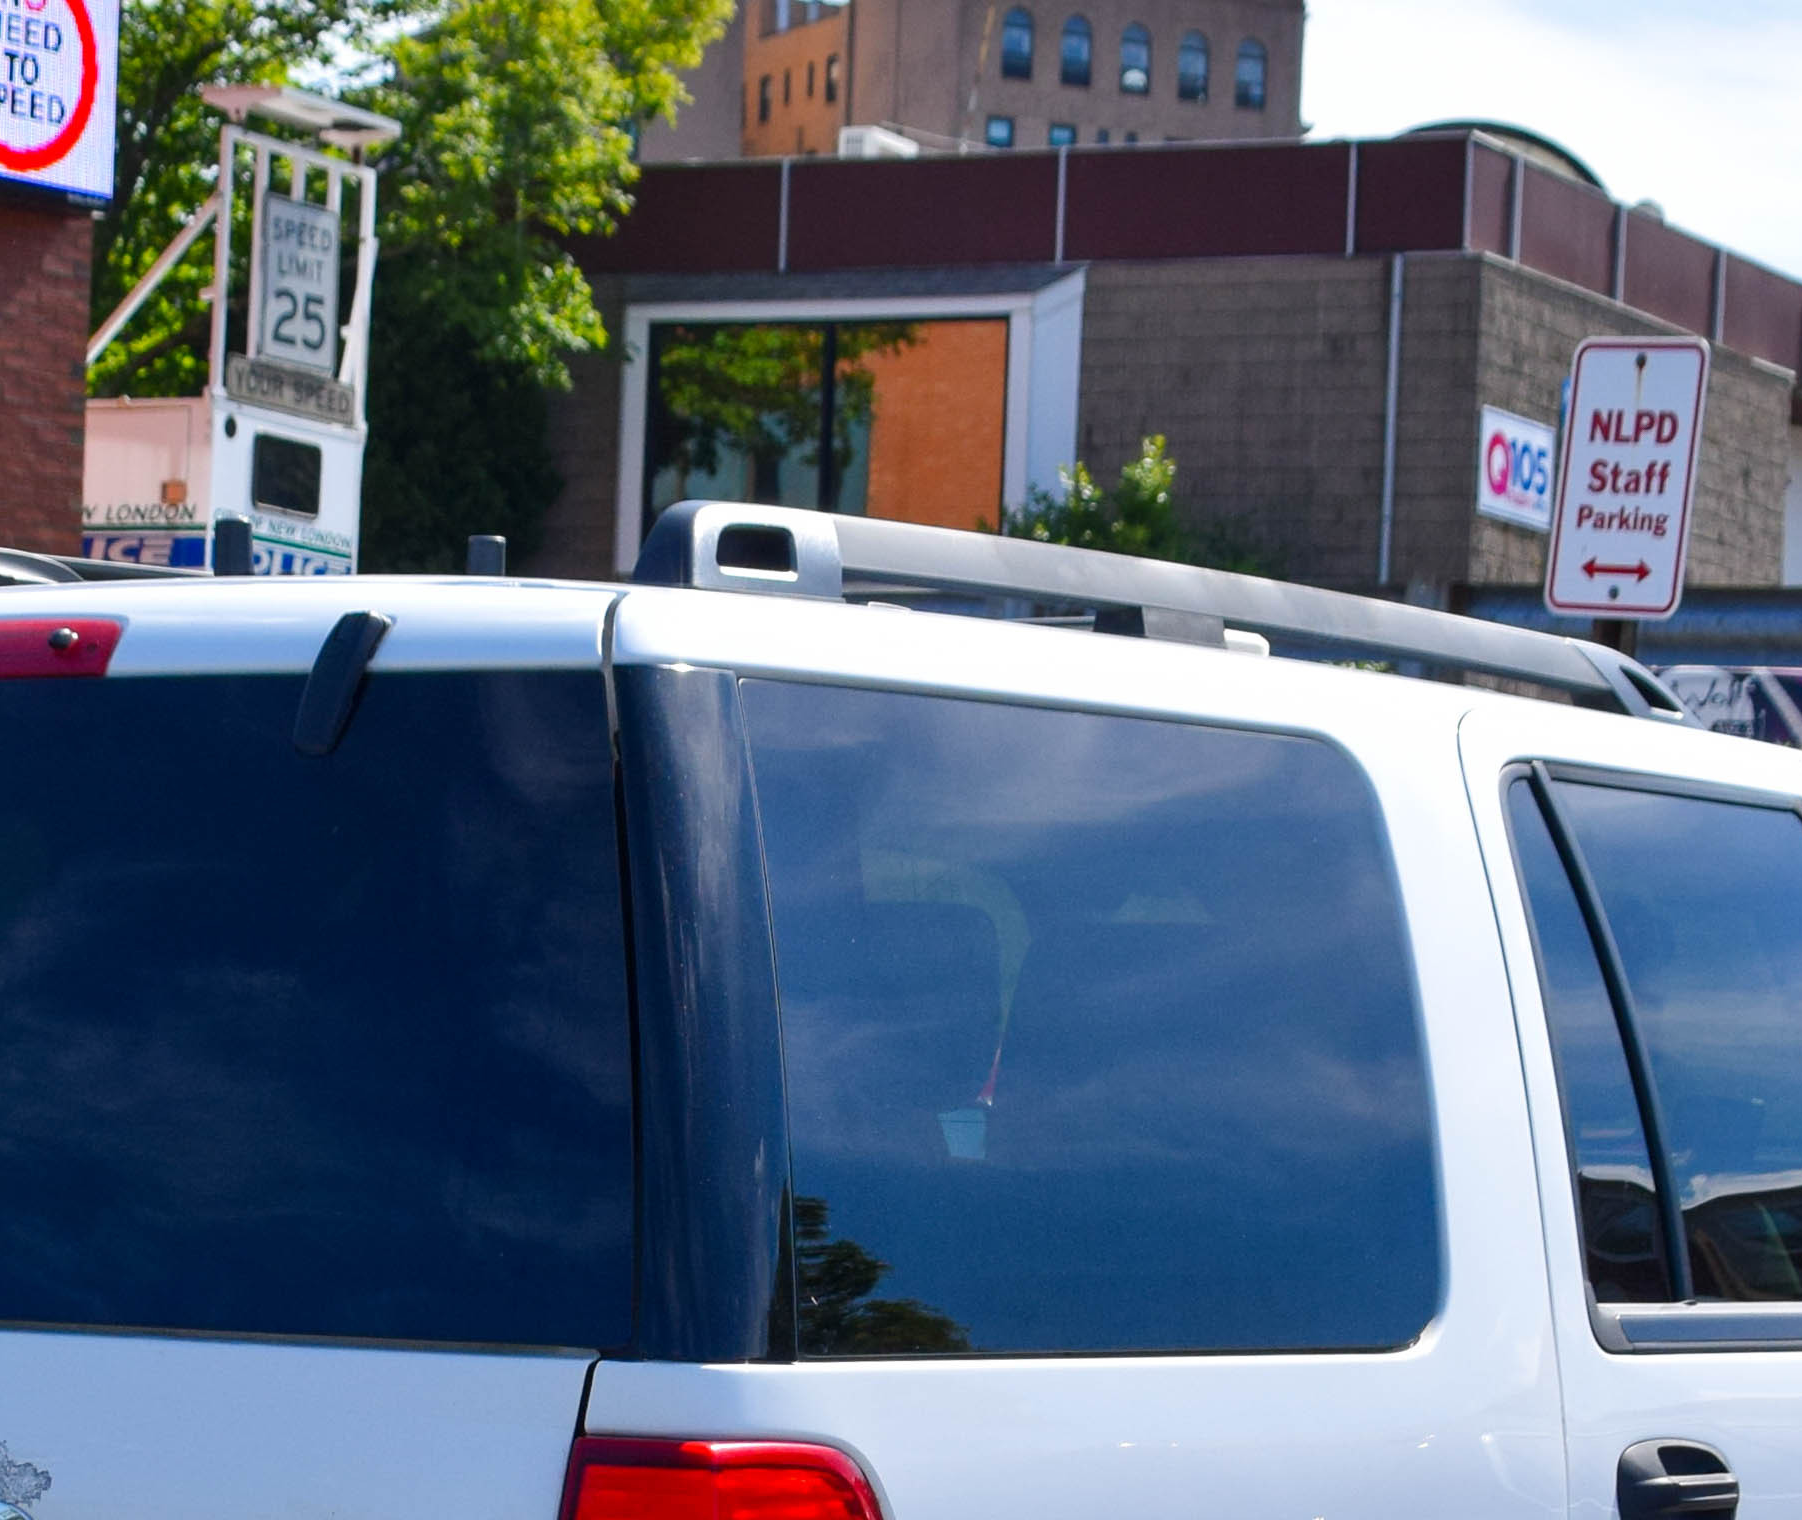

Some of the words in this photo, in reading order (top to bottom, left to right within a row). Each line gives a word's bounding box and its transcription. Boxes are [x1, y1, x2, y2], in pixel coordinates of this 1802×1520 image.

[4, 49, 39, 86] TO
[272, 216, 332, 252] SPEED
[278, 253, 324, 283] LIMIT
[271, 287, 326, 351] 25
[232, 364, 285, 399] YOUR
[294, 380, 351, 414] SPEED
[1589, 409, 1679, 445] NLPD
[1487, 432, 1547, 495] Q105
[1587, 459, 1671, 495] Staff
[105, 503, 198, 522] LONDON
[1576, 504, 1669, 537] Parking
[301, 527, 353, 549] LONDON
